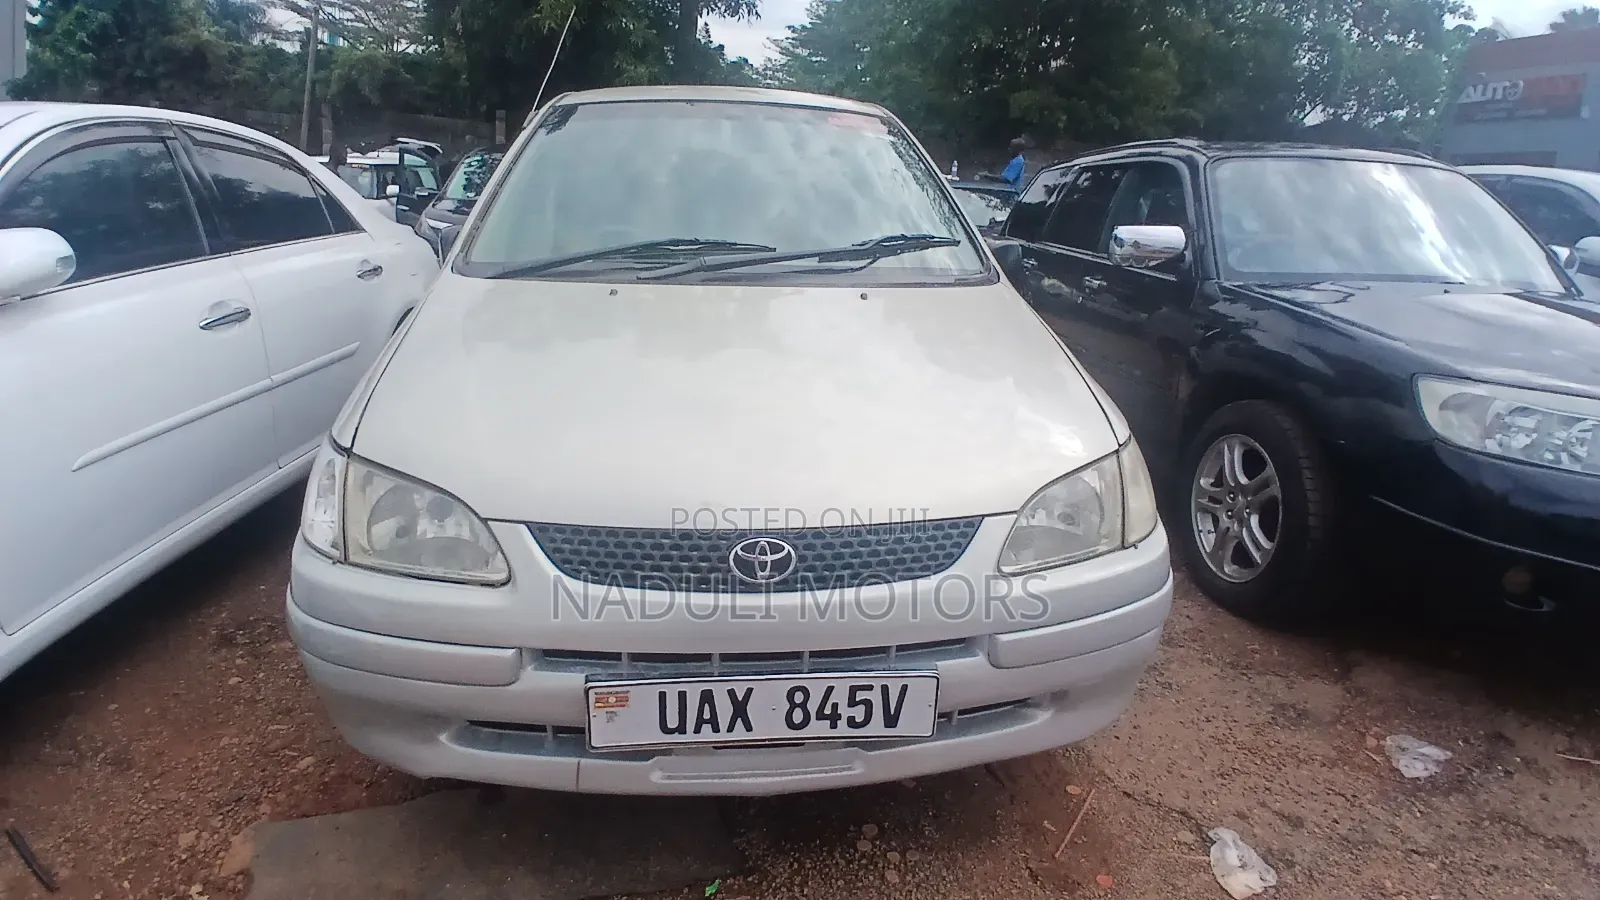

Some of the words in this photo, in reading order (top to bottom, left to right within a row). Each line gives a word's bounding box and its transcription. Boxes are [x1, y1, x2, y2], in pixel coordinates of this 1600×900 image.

[1456, 80, 1524, 104] AUTO
[658, 687, 755, 735] UAX
[784, 684, 909, 732] 845V
